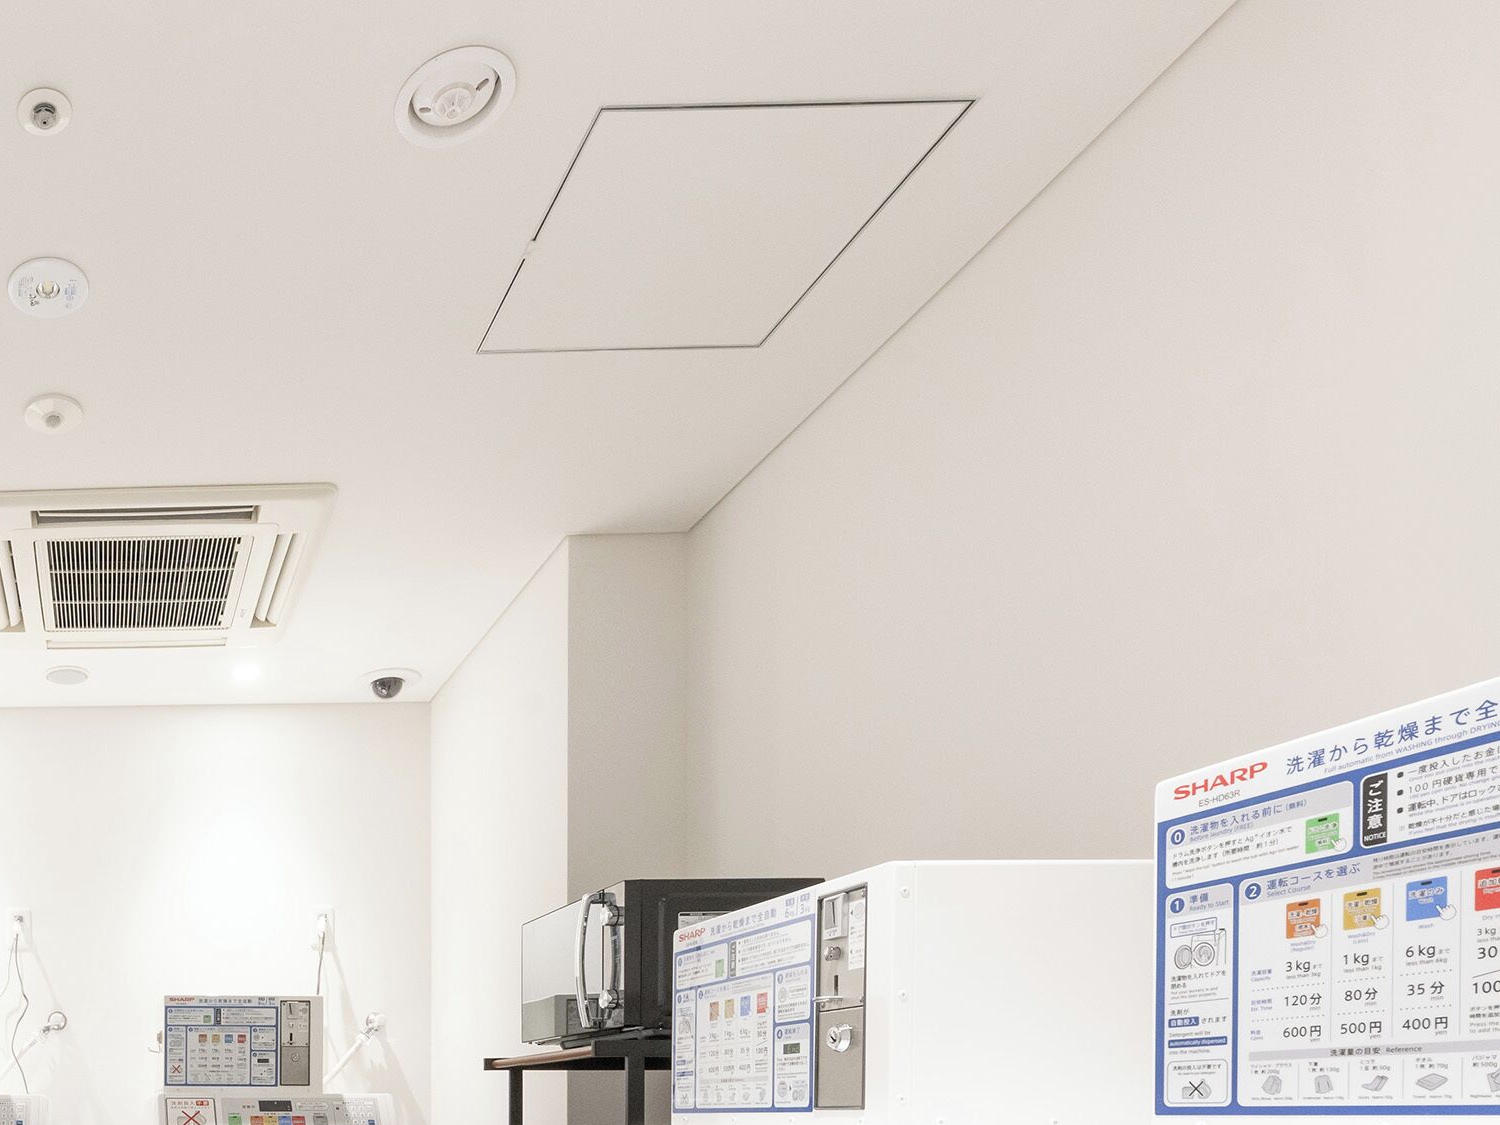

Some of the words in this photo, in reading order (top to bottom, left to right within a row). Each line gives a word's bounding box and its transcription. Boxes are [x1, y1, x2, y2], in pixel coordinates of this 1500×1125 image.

[1338, 756, 1374, 772] automatic
[1375, 751, 1394, 762] from
[1396, 738, 1433, 755] WASHING
[1434, 729, 1468, 746] through
[1407, 745, 1500, 774] 一度投入したお金
[1174, 762, 1268, 800] SHARP
[1198, 789, 1241, 808] ES-HD63R
[1367, 780, 1384, 830] ご注意
[1189, 805, 1283, 835] 洗濯物を入れる前に
[1363, 831, 1387, 843] NOTICE
[1267, 862, 1361, 890] 運転コースを選ぶ
[1249, 886, 1258, 898] 2
[1267, 887, 1287, 898] Select
[1287, 884, 1312, 895] Course
[678, 927, 706, 943] SHARP
[1485, 927, 1497, 936] kg
[1405, 945, 1414, 958] 6
[1418, 944, 1436, 959] kg
[1477, 946, 1498, 959] 30
[1295, 960, 1311, 972] kg
[1353, 953, 1370, 966] kg
[1330, 1046, 1381, 1057] 洗濯量の目安
[1385, 1045, 1423, 1054] Reference
